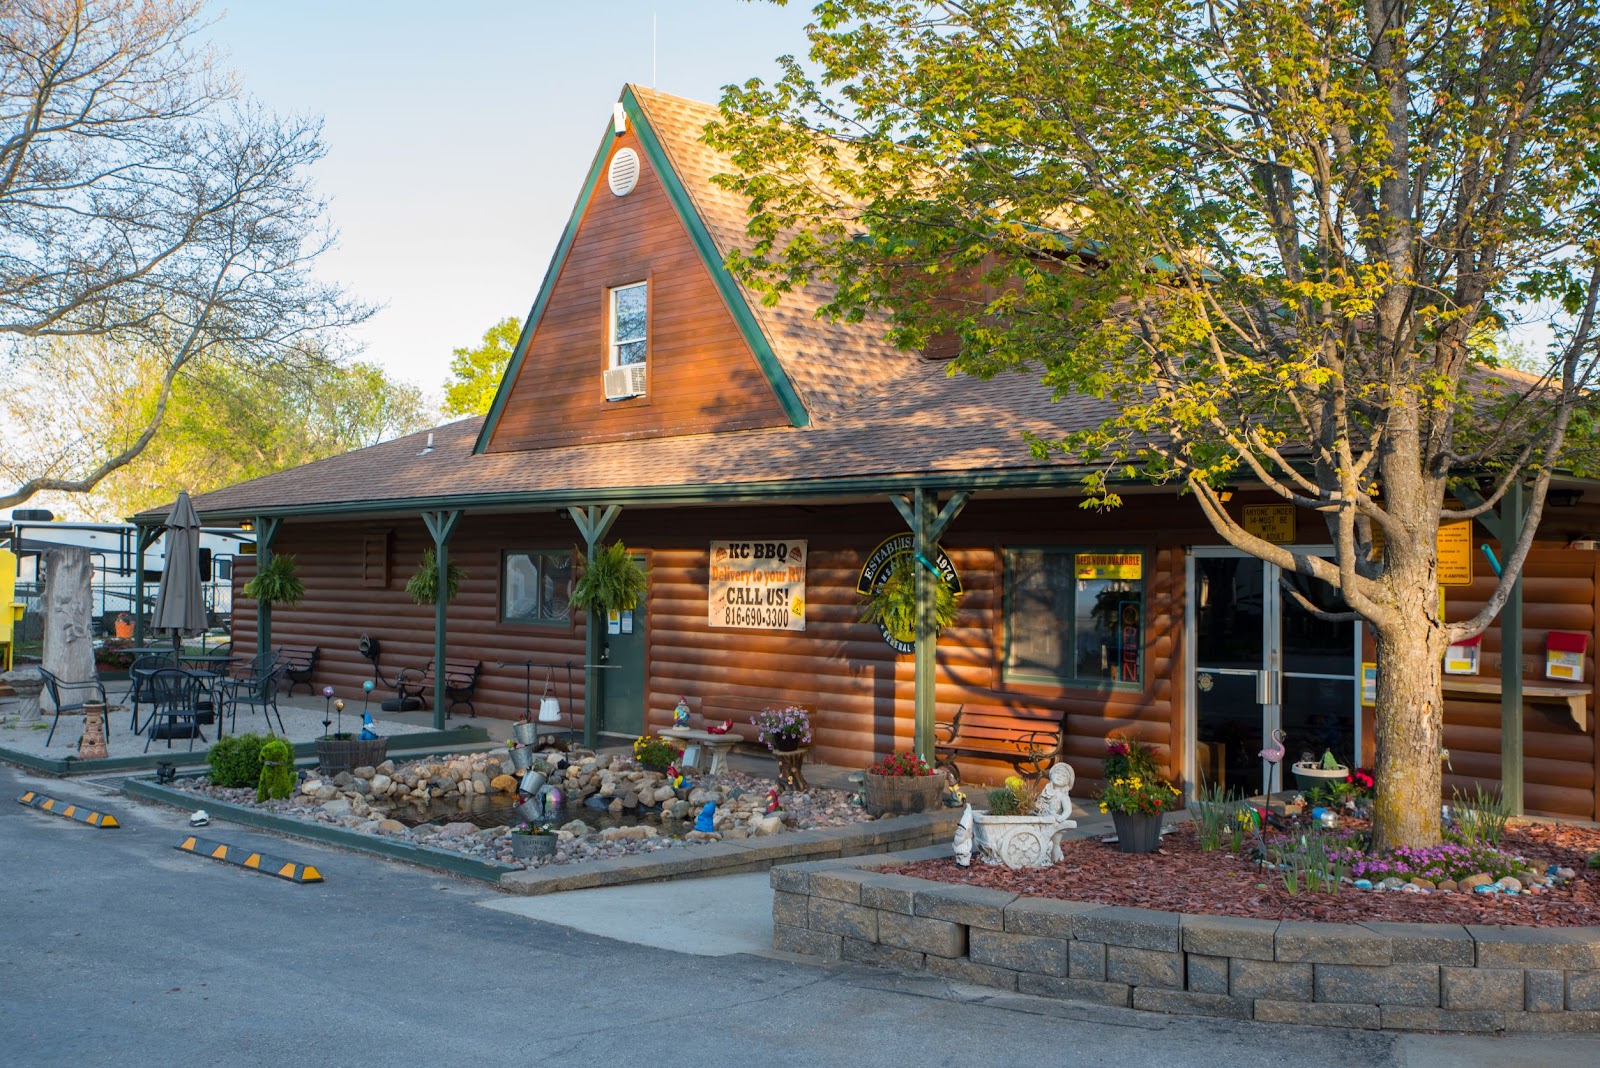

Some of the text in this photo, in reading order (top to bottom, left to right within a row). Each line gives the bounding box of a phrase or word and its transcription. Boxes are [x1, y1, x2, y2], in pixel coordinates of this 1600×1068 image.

[1246, 508, 1269, 516] ANYONE
[729, 543, 788, 563] KC BBQ
[864, 536, 916, 580] ESTABLIS
[1076, 555, 1140, 566] BEER NOW AVAILABLE
[712, 566, 805, 586] Delivery to your RV!
[936, 554, 955, 582] 1974
[726, 587, 789, 607] CALL US!
[725, 606, 789, 628] 816-690-3300
[882, 630, 911, 653] GENERAL
[1122, 605, 1139, 682] OPEN
